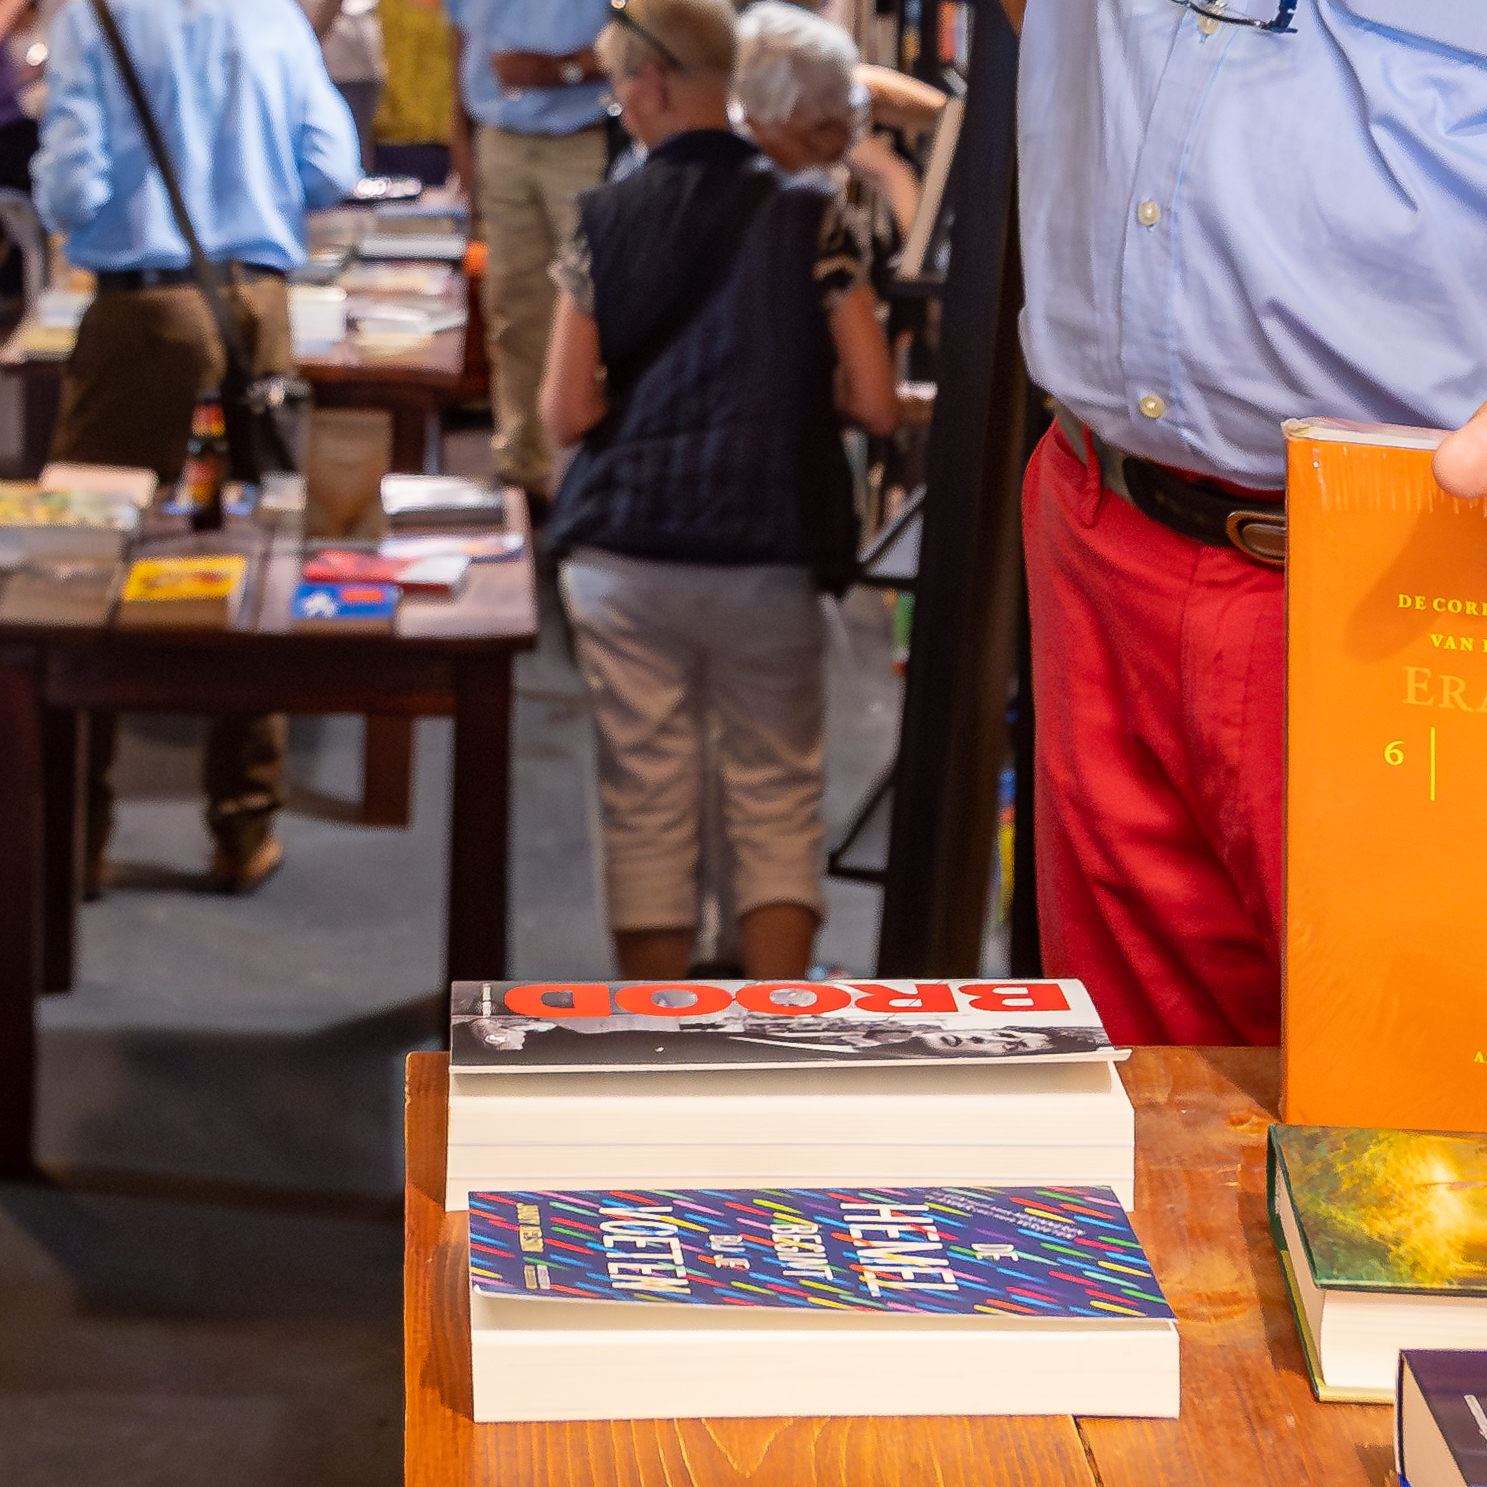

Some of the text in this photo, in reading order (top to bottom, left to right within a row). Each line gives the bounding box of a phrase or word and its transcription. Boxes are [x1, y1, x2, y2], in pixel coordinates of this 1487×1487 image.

[1397, 593, 1426, 611] DE
[1430, 633, 1474, 653] VAN
[1383, 739, 1405, 767] 6
[504, 982, 1072, 1018] BROOD
[598, 1206, 692, 1294] VOETEN
[769, 1222, 834, 1280] BEGINT
[839, 1202, 959, 1297] HEMEL
[971, 1243, 1019, 1262] DE
